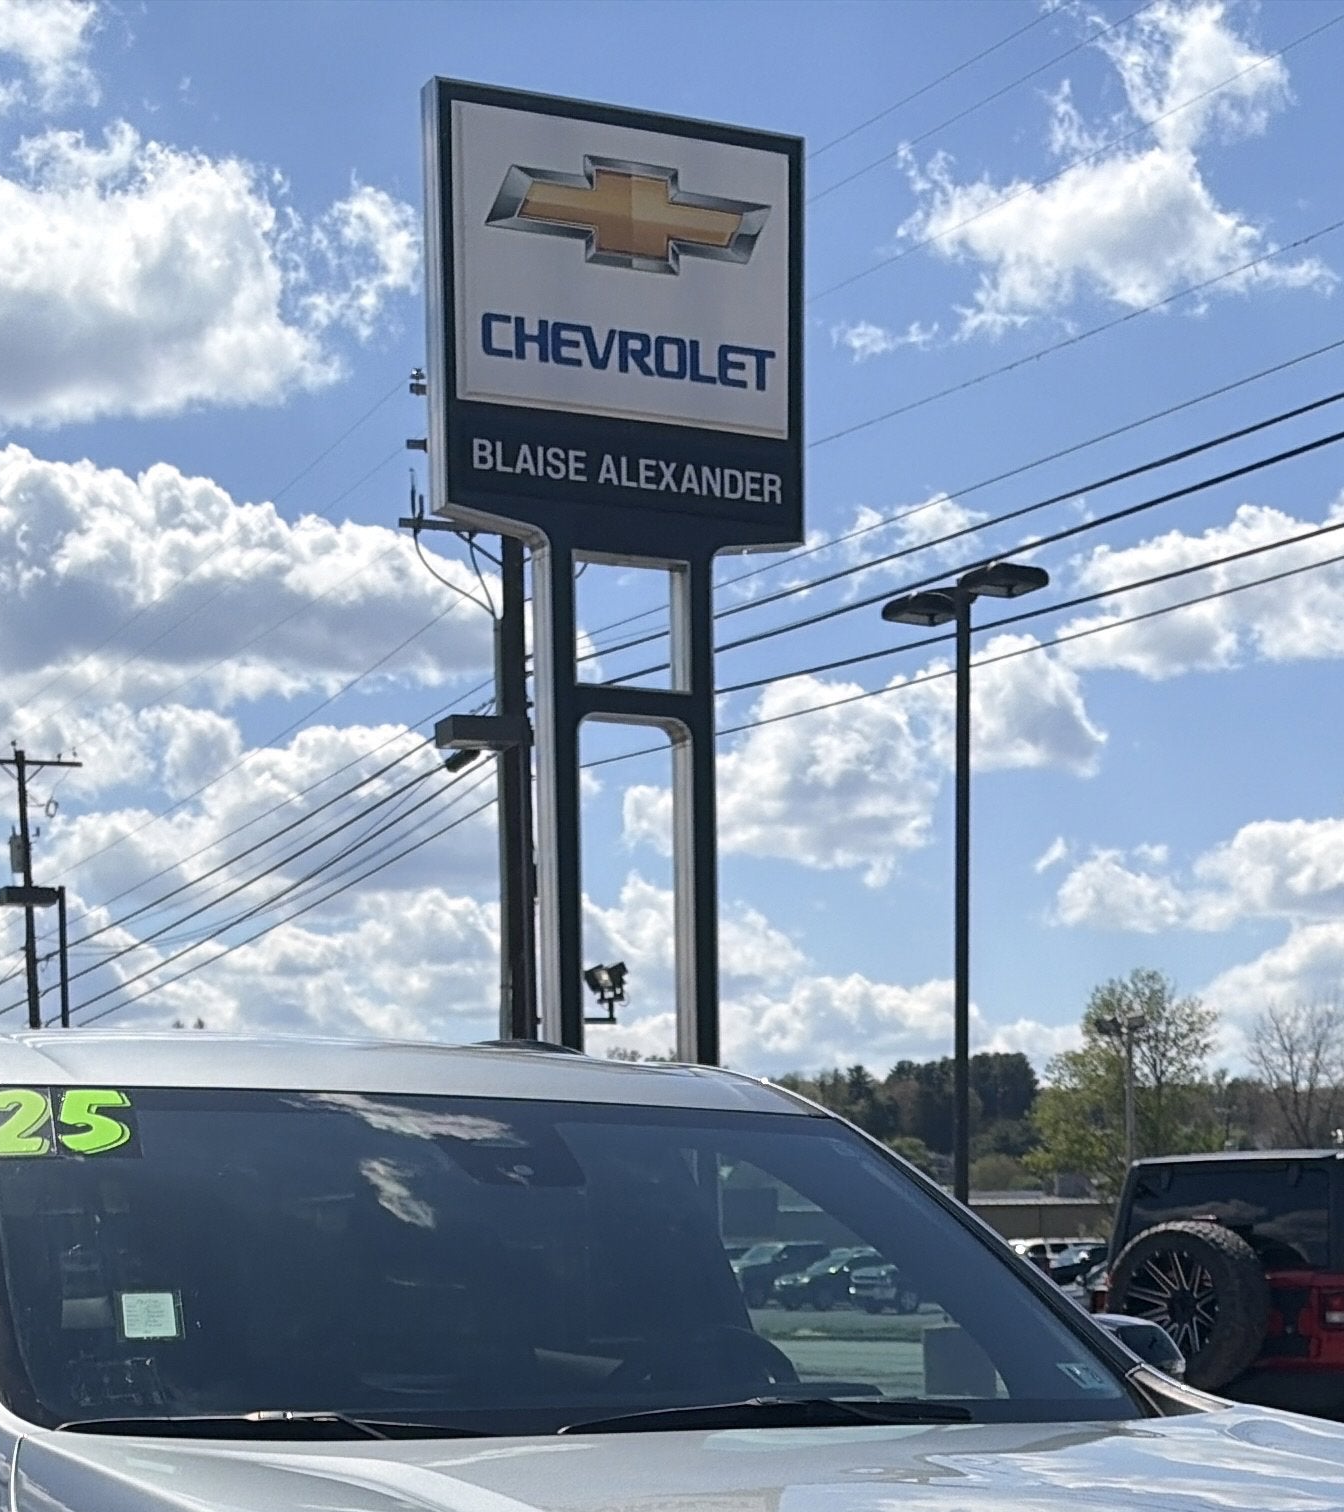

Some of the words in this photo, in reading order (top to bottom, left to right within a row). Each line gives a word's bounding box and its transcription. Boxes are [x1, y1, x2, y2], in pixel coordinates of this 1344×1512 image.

[481, 312, 776, 392] CHEVROLET
[472, 438, 588, 483] BLAISE
[597, 453, 783, 505] ALEXANDER
